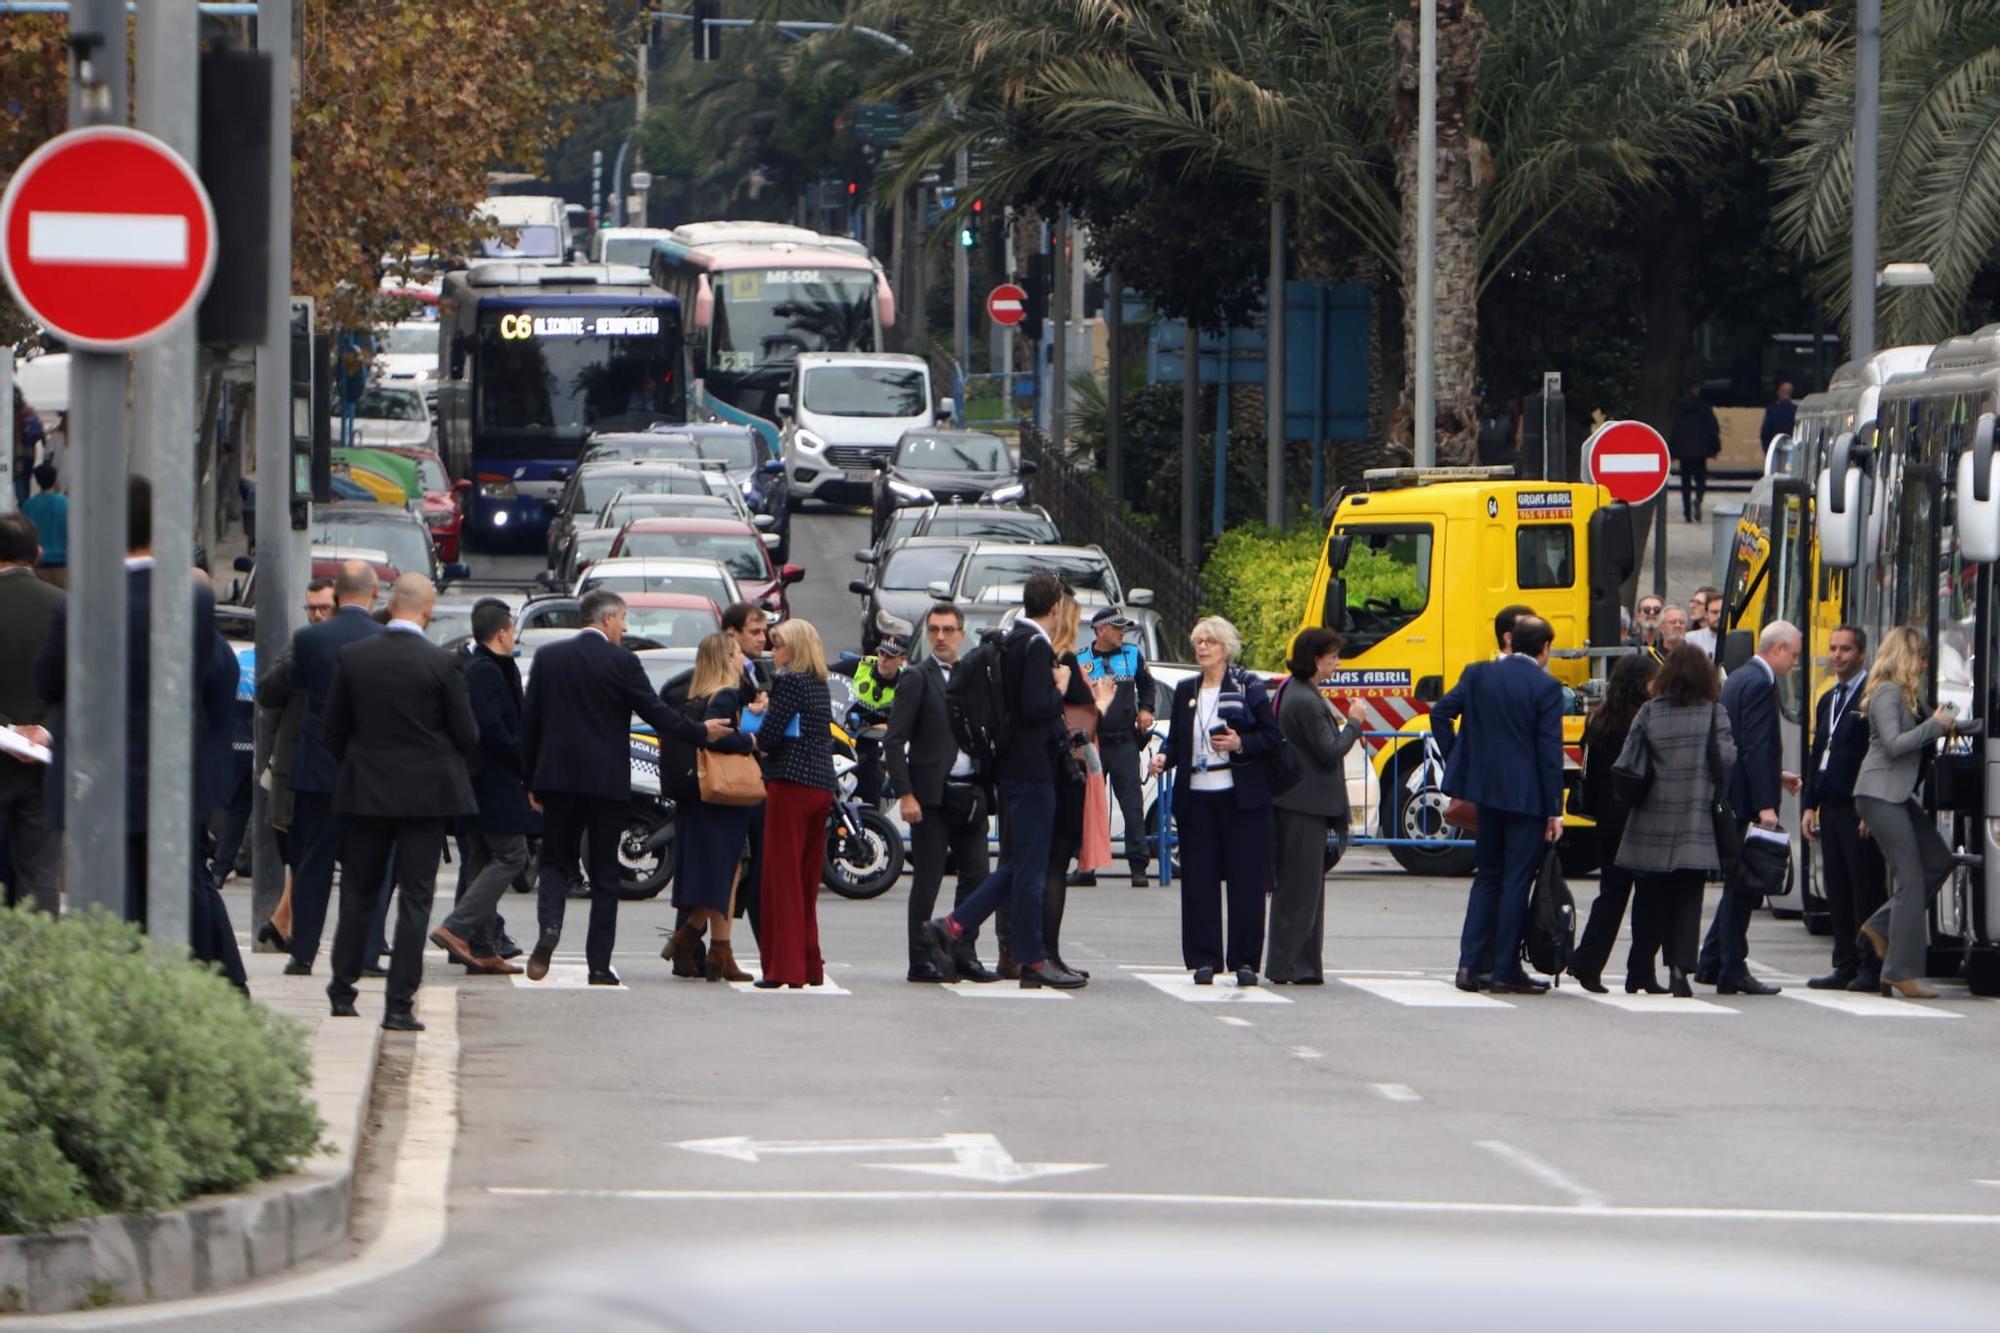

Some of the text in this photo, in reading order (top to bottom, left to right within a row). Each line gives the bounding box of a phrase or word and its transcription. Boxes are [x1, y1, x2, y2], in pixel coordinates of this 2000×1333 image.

[765, 270, 822, 284] MI-SOL
[501, 313, 532, 340] C6
[1517, 493, 1571, 505] GRUAS ABRIL
[1321, 671, 1410, 684] UAS ABRIL
[1321, 688, 1409, 698] 65 91 61 91
[630, 740, 650, 752] LICIA
